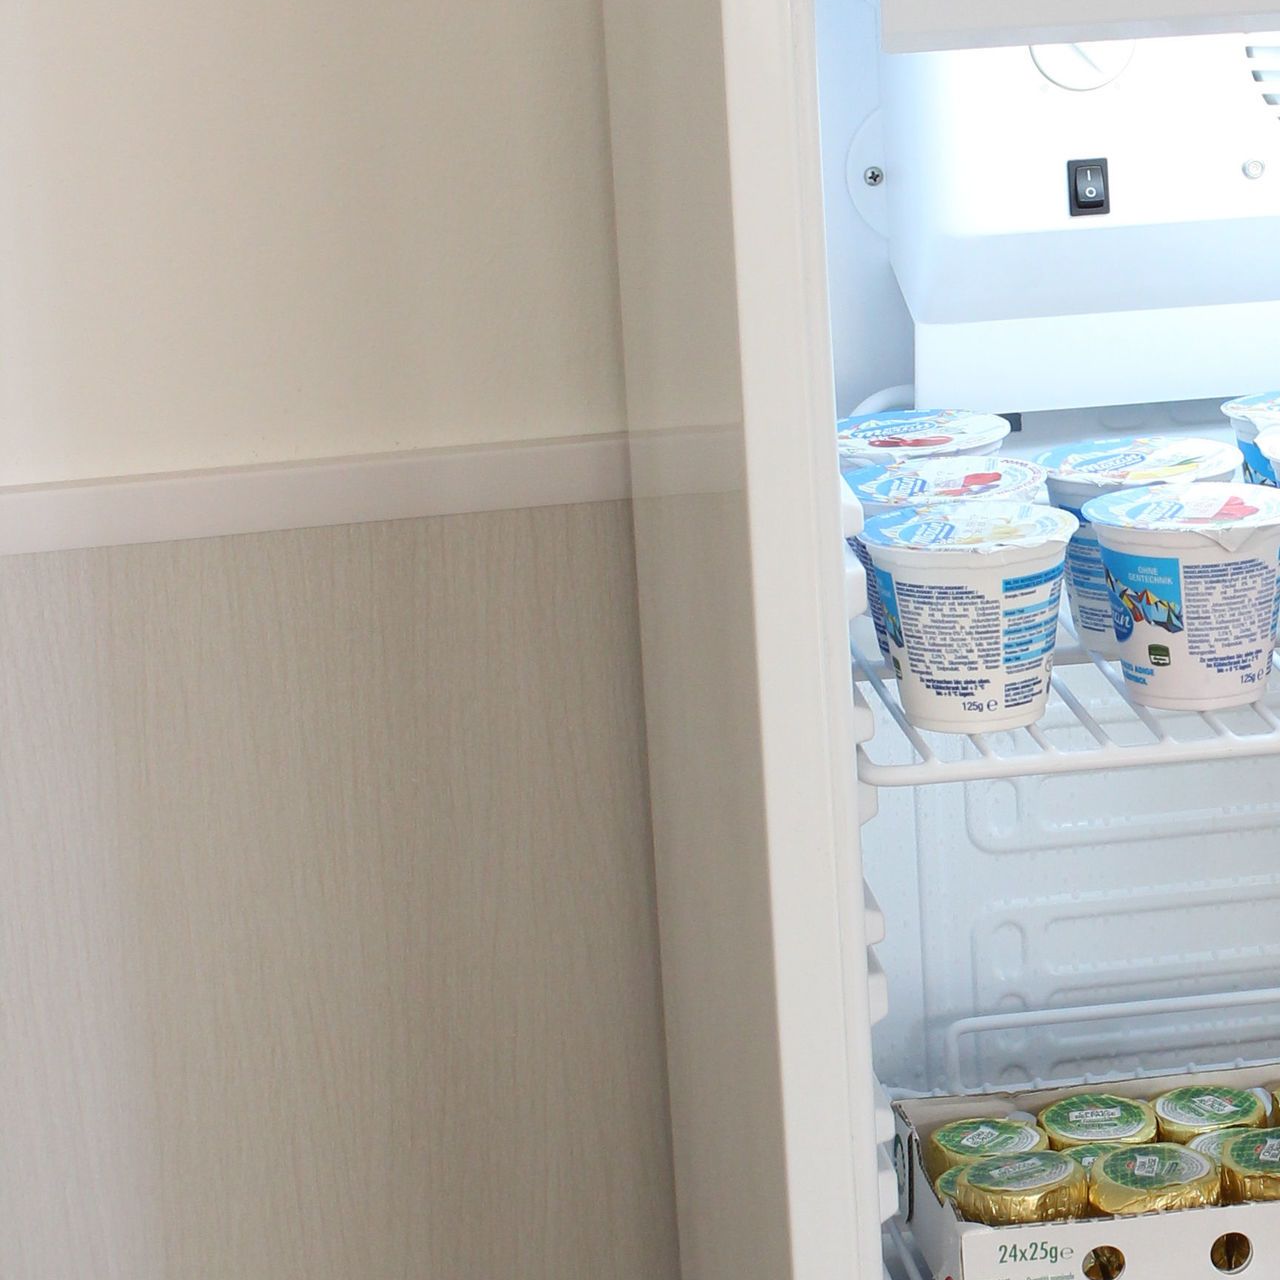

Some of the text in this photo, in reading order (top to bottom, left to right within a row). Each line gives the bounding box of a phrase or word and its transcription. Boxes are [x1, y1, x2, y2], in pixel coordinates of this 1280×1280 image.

[1137, 566, 1158, 576] OHNE
[1128, 573, 1173, 584] GENTECHNIK
[1240, 672, 1255, 684] 125g
[962, 701, 984, 712] 125g
